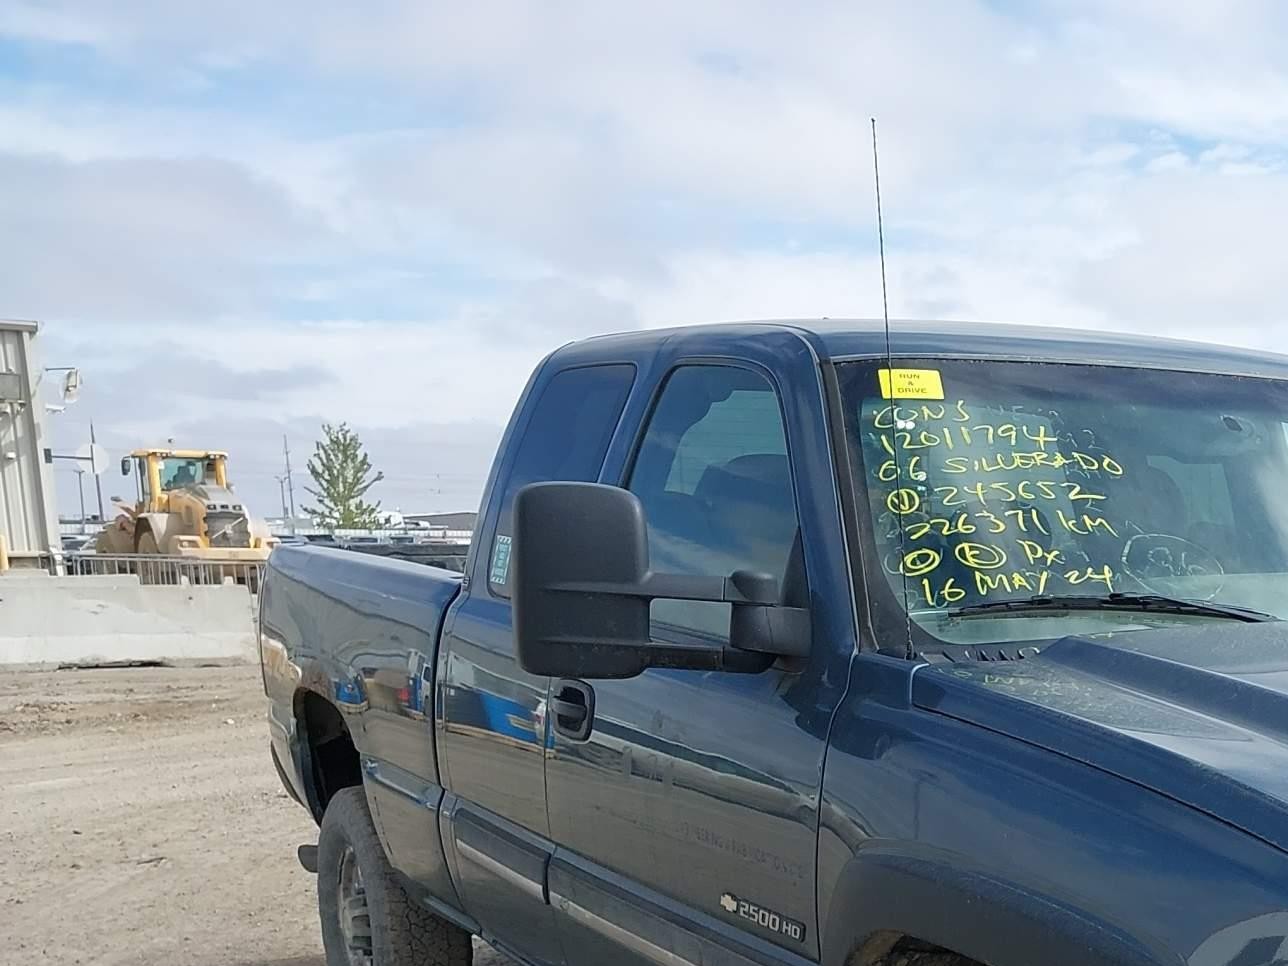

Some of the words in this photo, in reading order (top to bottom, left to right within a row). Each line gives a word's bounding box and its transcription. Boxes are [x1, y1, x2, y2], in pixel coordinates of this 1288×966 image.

[881, 424, 1057, 455] 12011794
[935, 481, 1106, 505] 245652
[922, 578, 965, 605] 16
[975, 571, 1048, 596] MAY
[1064, 565, 1114, 592] 24
[740, 901, 780, 932] 2500
[782, 921, 801, 939] HD
